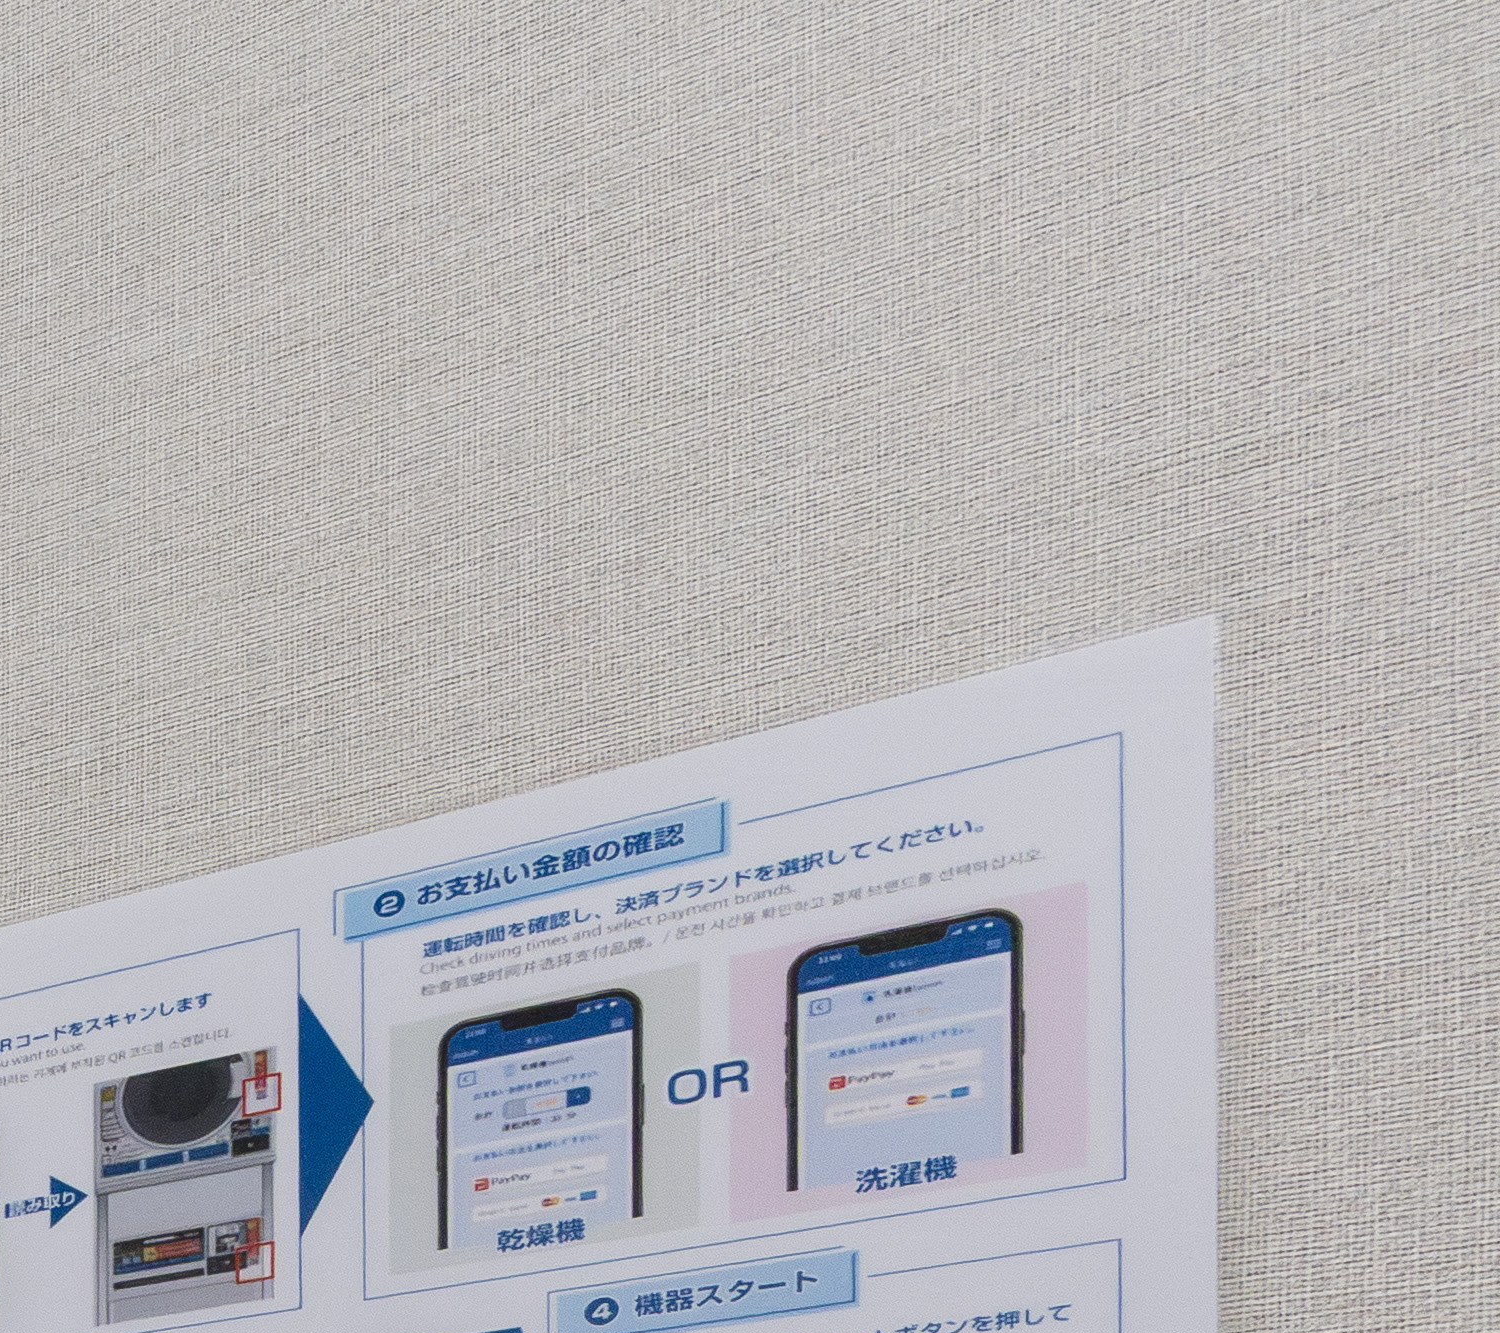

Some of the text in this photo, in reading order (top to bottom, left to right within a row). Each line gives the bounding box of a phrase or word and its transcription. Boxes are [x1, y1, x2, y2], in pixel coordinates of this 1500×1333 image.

[417, 822, 685, 906] お支払い金額の確認
[422, 819, 985, 959] 運転時間を確認し、決済ブランドを選択してください。
[419, 881, 797, 975] Check driving times and select payment brands.
[11, 1050, 44, 1065] want
[46, 1047, 58, 1059] to
[666, 1058, 751, 1108] OR
[490, 1171, 532, 1187] PayPay
[855, 1154, 958, 1195] 洗濯機
[6, 1186, 77, 1220] 読み取り
[496, 1217, 587, 1253] 乾燥機
[633, 1270, 818, 1318] 機器スタート
